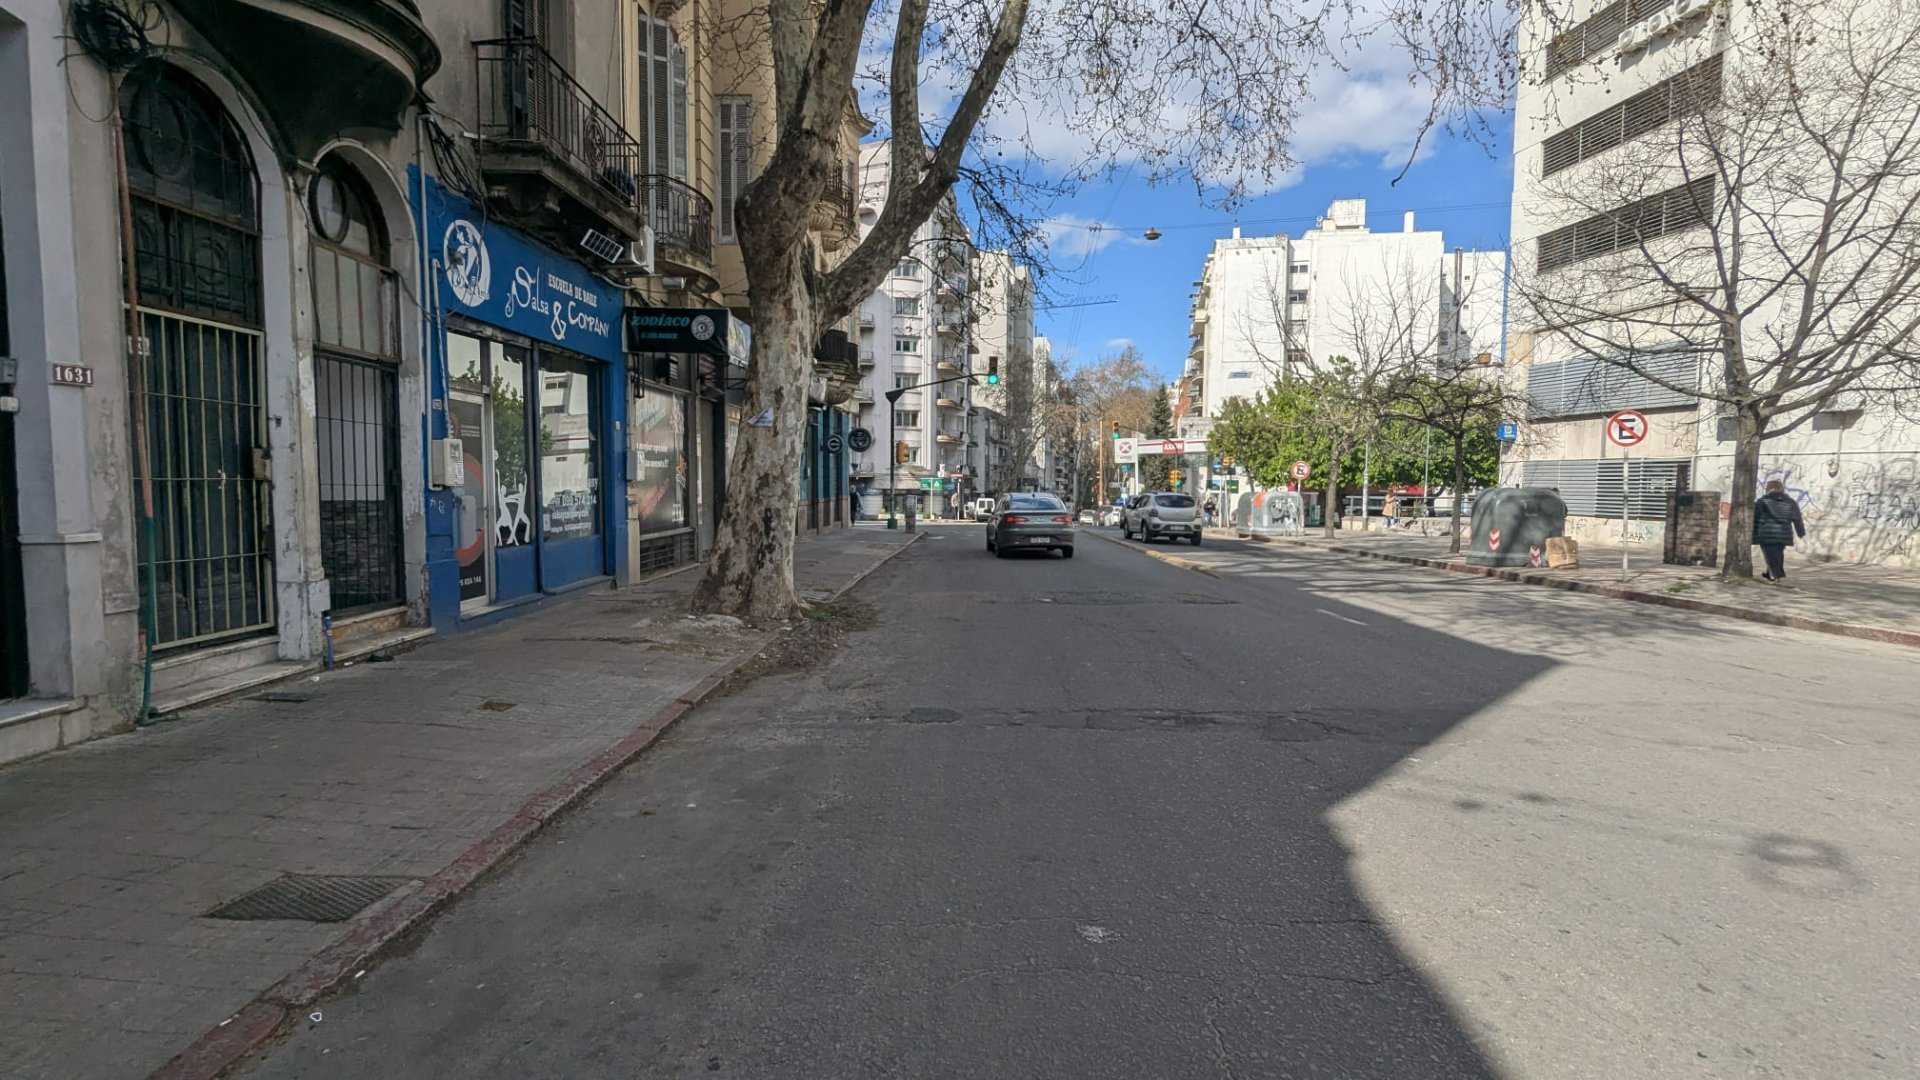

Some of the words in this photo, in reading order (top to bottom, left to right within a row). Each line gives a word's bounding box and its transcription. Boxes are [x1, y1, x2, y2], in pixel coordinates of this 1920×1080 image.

[548, 273, 574, 297] ESCUELA
[574, 285, 583, 301] DE
[505, 265, 550, 318] Salsa
[551, 300, 566, 340] &
[55, 366, 93, 384] 1631
[1618, 418, 1636, 440] E
